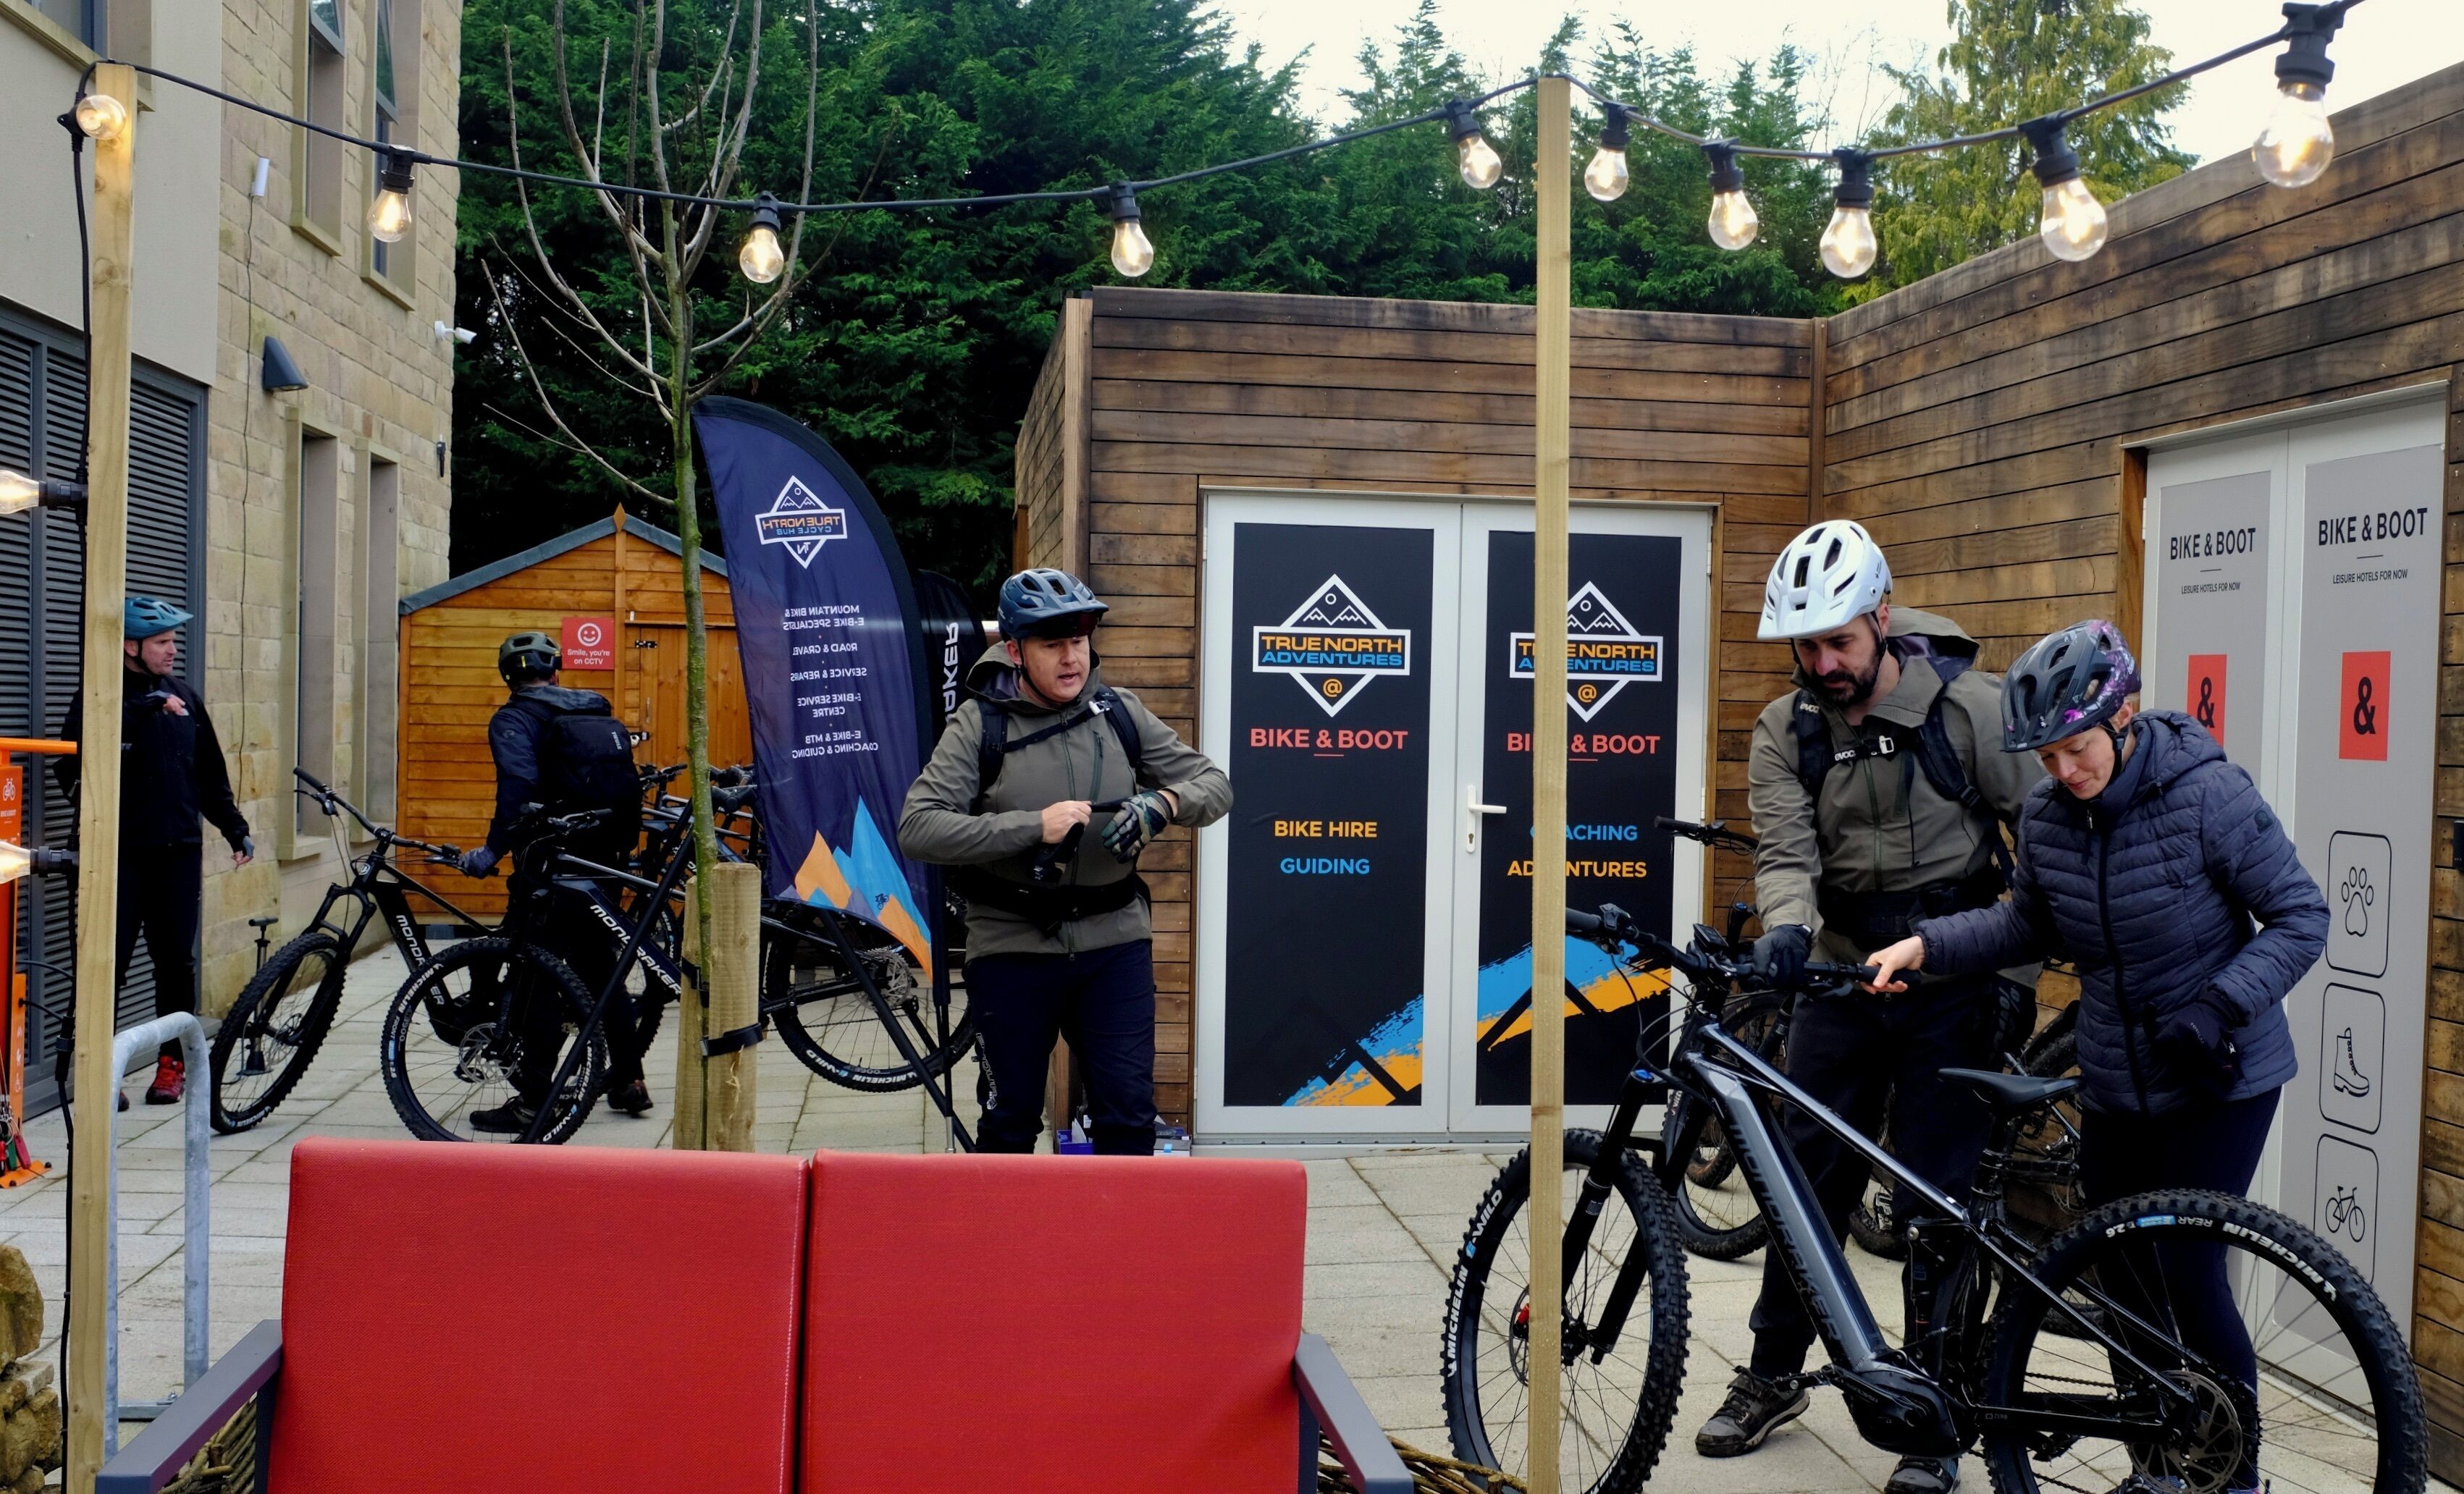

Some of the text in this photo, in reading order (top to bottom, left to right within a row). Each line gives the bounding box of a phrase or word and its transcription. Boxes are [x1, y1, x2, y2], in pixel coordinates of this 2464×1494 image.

[2318, 507, 2428, 546] BIKE & BOOT
[2170, 528, 2256, 560] BIKE & BOOT
[2333, 569, 2408, 585] LEISURE HOTELS FOR NOW
[2181, 581, 2241, 594] LEISURE HOTELS FOR NOW
[1261, 636, 1402, 653] TRUE NORTH
[1518, 642, 1654, 659] TE NORTH
[1261, 651, 1403, 666] ADVENTURES
[1518, 657, 1654, 672] AENTURES
[1323, 678, 1343, 698] @
[1578, 684, 1597, 703] @
[2197, 677, 2215, 728] &
[2353, 677, 2376, 735] &
[1250, 728, 1408, 749] BIKE & BOOT
[1571, 734, 1587, 753] &
[1593, 735, 1660, 754] BOOT
[1274, 821, 1377, 837] BIKE HIRE
[1280, 858, 1370, 874] GUIDING
[1507, 861, 1647, 877] ADNTURES
[398, 968, 434, 1014] MICHELIN
[852, 1074, 907, 1084] MICHELIN
[1466, 1189, 1503, 1259] E-WILD
[2177, 1215, 2214, 1228] REAR
[2222, 1221, 2324, 1285] MICHELIN
[1447, 1265, 1469, 1359] MICHELIN
